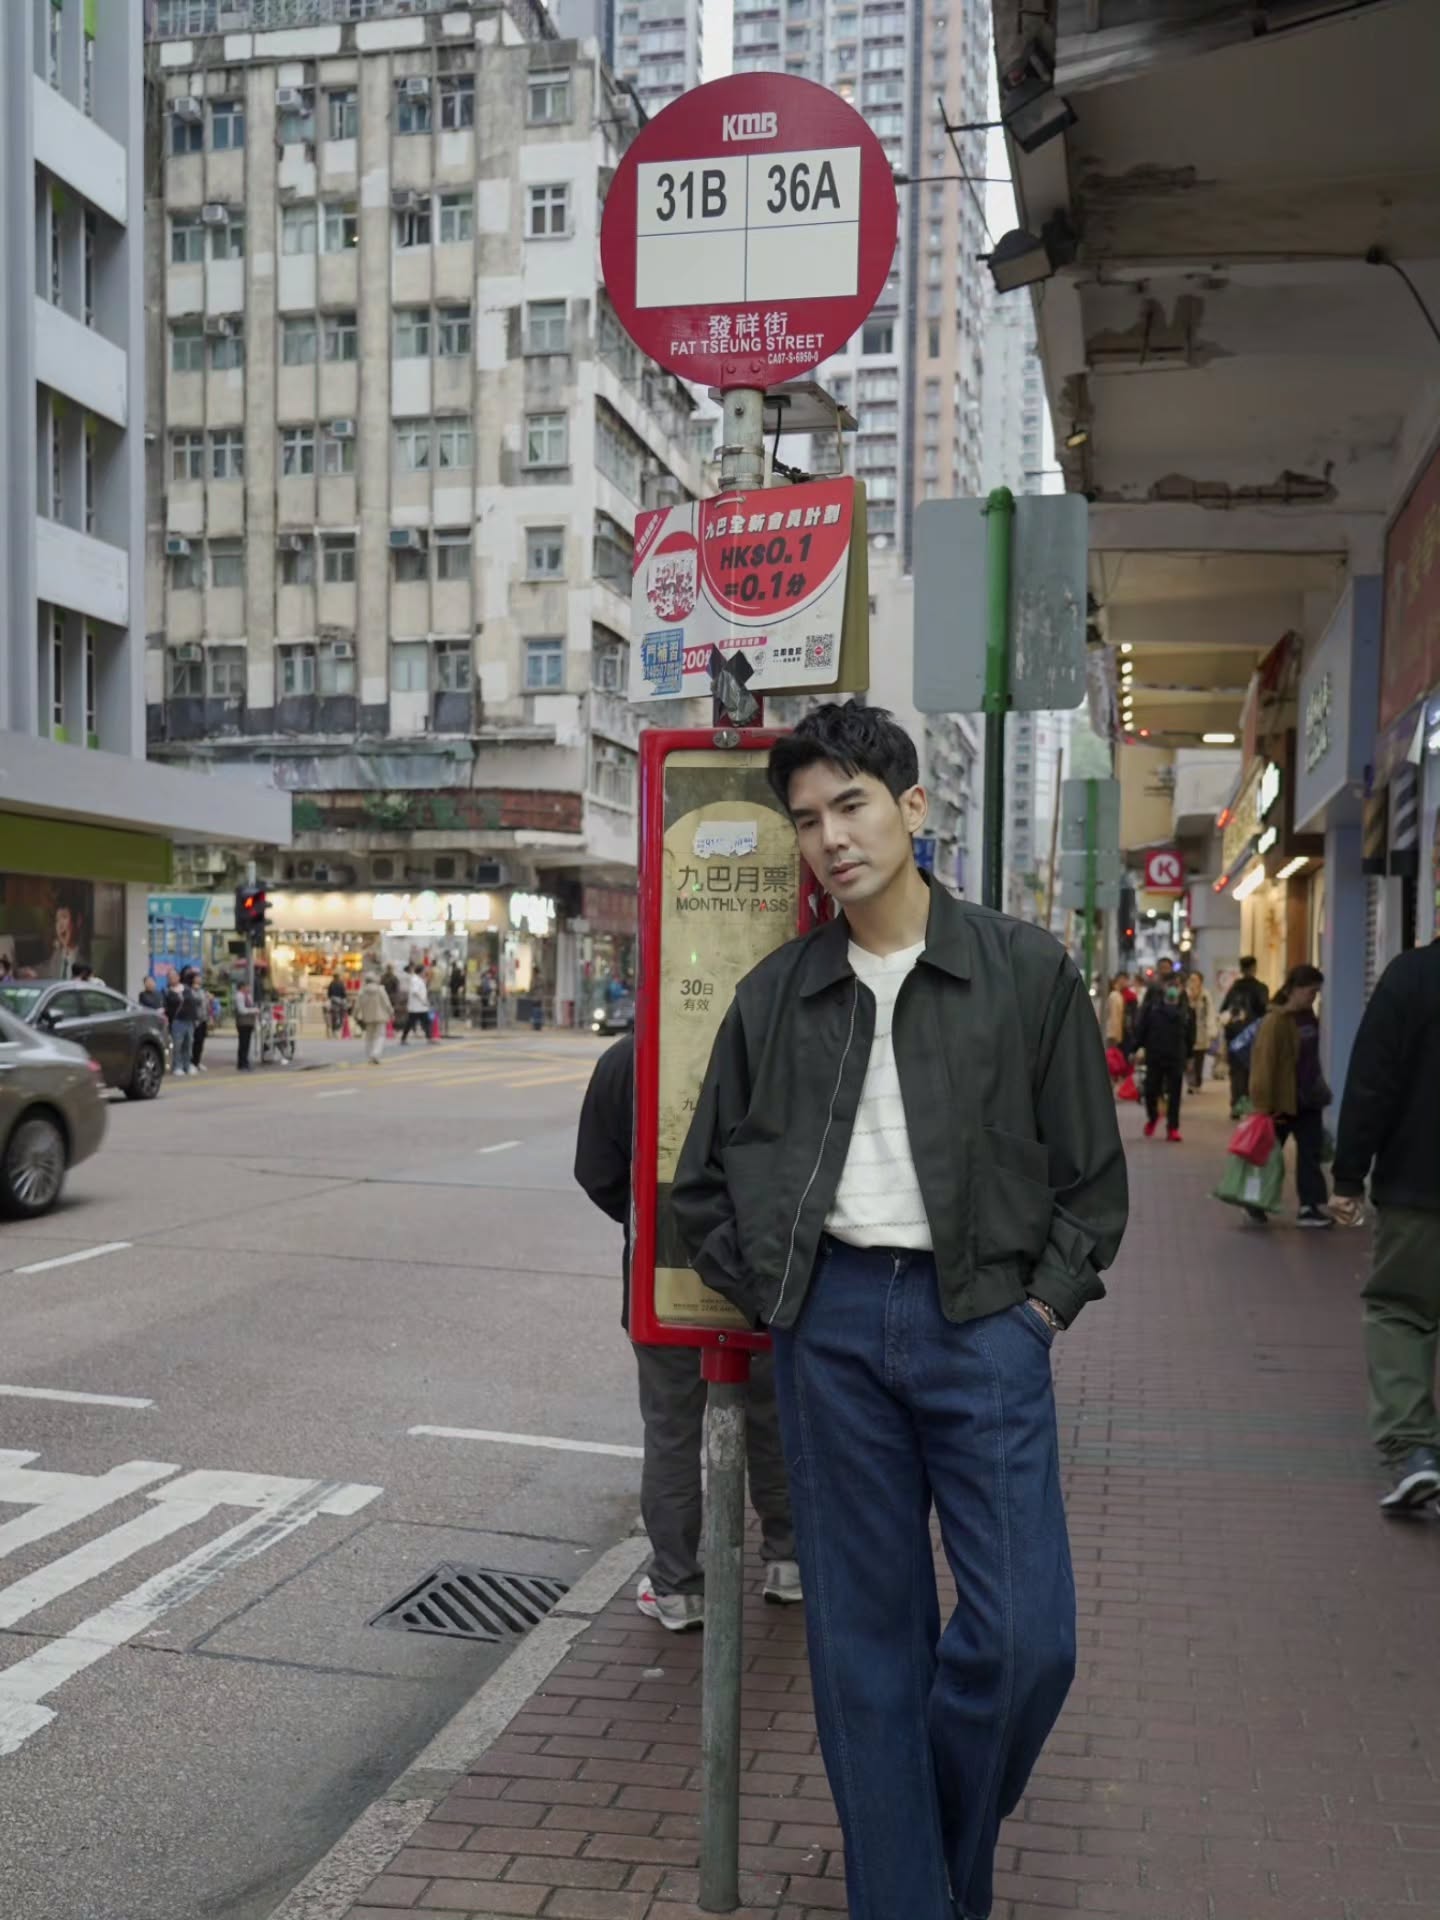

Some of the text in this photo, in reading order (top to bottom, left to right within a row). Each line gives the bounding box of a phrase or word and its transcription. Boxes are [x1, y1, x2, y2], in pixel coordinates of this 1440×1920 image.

[656, 160, 841, 222] 31B 36A
[708, 311, 788, 340] 發祥街
[670, 334, 825, 356] FAT TSEUNG STREET
[704, 503, 841, 541] 九巴全新會員計劃
[720, 533, 812, 571] HK$0.1
[677, 865, 790, 893] 九巴月票
[676, 896, 789, 913] MONTHLY PASS
[680, 979, 714, 996] 30日
[683, 998, 710, 1012] 有效
